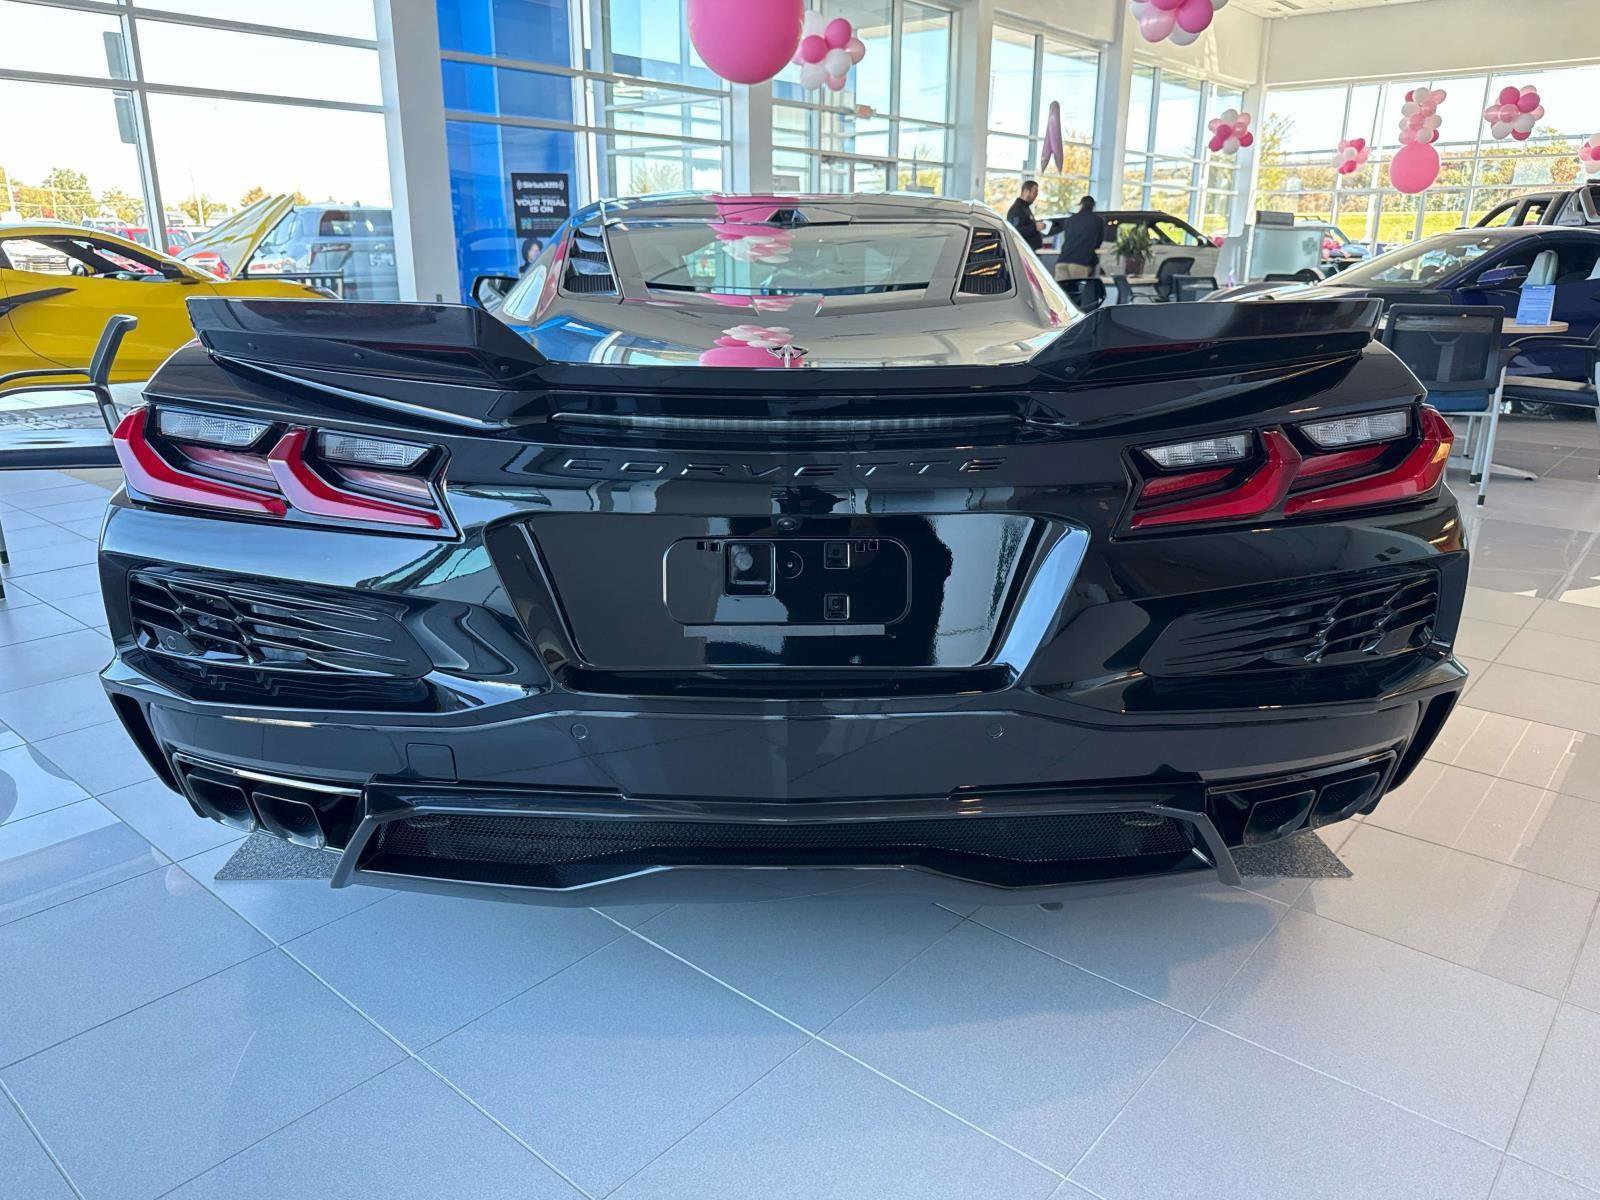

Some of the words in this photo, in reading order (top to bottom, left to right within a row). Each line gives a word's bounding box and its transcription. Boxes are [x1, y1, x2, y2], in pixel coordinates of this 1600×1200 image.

[516, 199, 541, 207] YOUR
[541, 199, 567, 207] TRIAL
[563, 456, 1007, 477] CORVETTE
